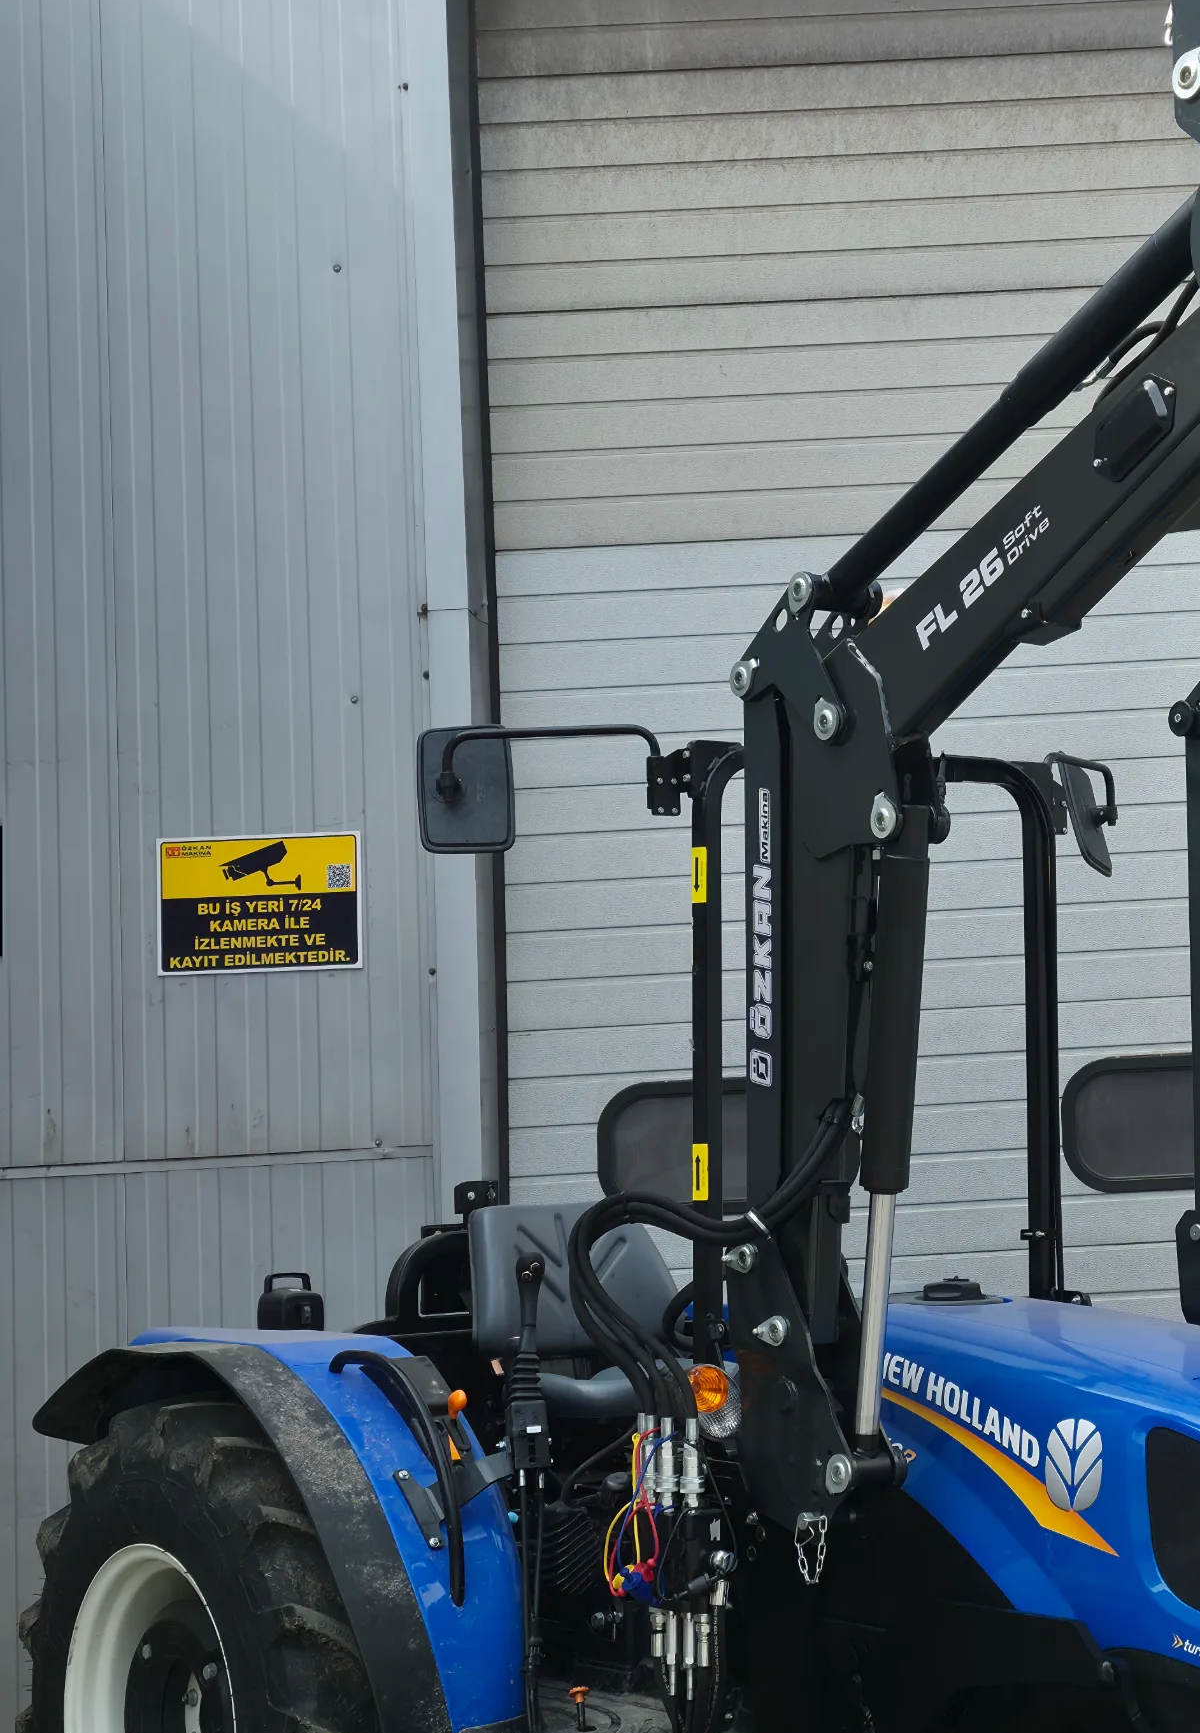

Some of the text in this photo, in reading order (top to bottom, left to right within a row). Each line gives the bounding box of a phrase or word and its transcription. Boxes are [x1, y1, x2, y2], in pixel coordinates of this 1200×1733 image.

[1002, 505, 1043, 550] Soft
[1006, 517, 1050, 566] Drive
[915, 547, 1005, 651] FL 26
[761, 792, 769, 860] Makina
[197, 898, 322, 916] BU İŞ YERİ 7/24
[210, 915, 310, 933] KAMERA İLE
[169, 948, 350, 969] KAYIT EDİLMEKTEDİR.
[194, 933, 326, 950] İZLENMEKTE VE
[751, 864, 772, 1039] ÖZKAN
[926, 1371, 1040, 1468] HOLLAND
